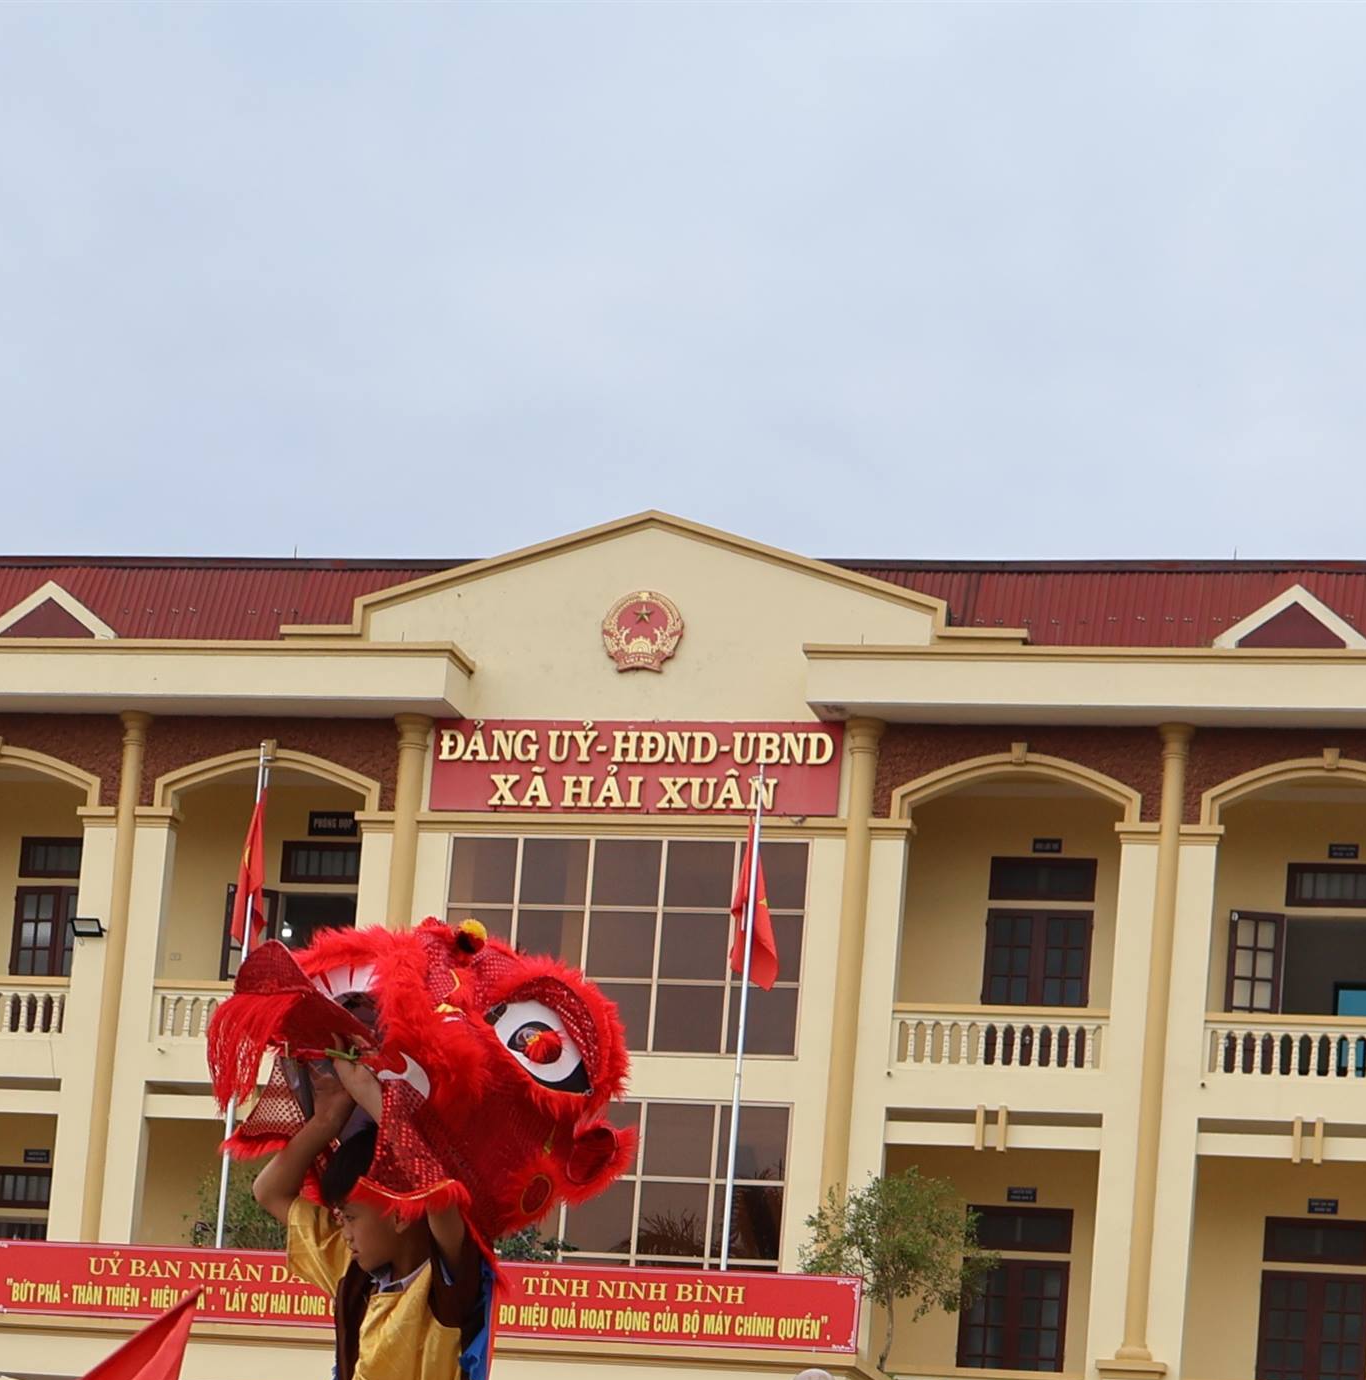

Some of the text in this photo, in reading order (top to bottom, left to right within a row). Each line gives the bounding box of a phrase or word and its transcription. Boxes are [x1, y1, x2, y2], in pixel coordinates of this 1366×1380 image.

[439, 720, 835, 766] ĐẢNG UỶ-HĐND-UBND
[487, 765, 778, 811] XÃ HẢI XUÂN
[89, 1251, 123, 1276] UỶ
[129, 1259, 182, 1278] BAN
[189, 1258, 264, 1282] NHÂN
[37, 1280, 61, 1304] PHÁ
[72, 1281, 103, 1305] THÂN
[106, 1283, 140, 1311] THIỆN
[150, 1284, 178, 1312] HIỆU
[251, 1290, 269, 1317] SỰ
[270, 1291, 291, 1314] HÀI
[293, 1289, 326, 1316] LÒNG
[522, 1270, 745, 1305] TỈNH NINH BÌNH
[498, 1304, 517, 1326] ĐO
[519, 1302, 549, 1331] HIỆU
[551, 1301, 577, 1329] QUẢ
[579, 1308, 613, 1334] HOẠT
[615, 1306, 651, 1335] ĐỘNG
[653, 1305, 679, 1333] CỦA
[681, 1309, 700, 1338] BỘ
[703, 1310, 732, 1335] MÁY
[735, 1312, 775, 1338] CHÍNH
